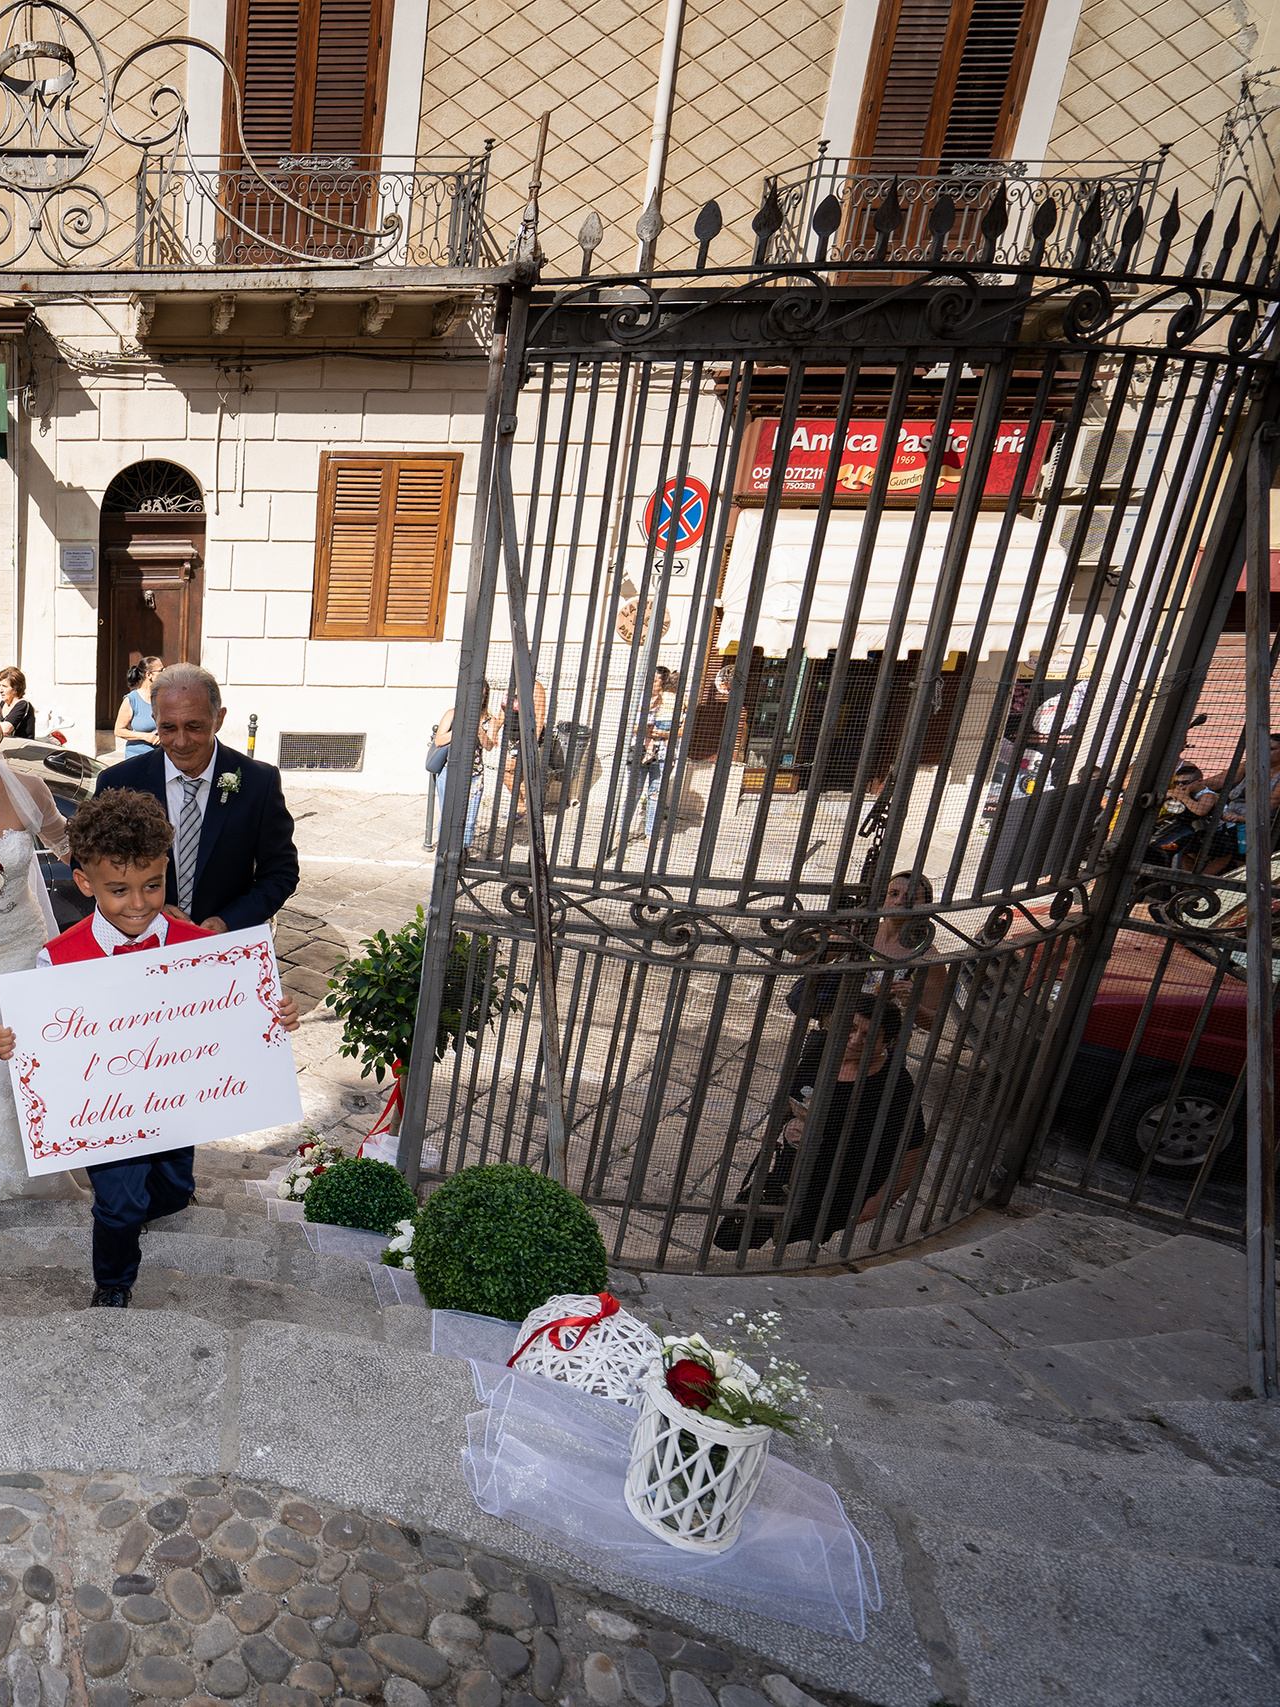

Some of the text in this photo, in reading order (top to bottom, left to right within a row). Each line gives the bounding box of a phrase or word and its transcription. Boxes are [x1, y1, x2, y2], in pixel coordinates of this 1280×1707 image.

[896, 455, 916, 464] 1969
[889, 473, 923, 487] Guardin
[41, 979, 248, 1042] Sta arrivando
[69, 1075, 248, 1128] della tua vita
